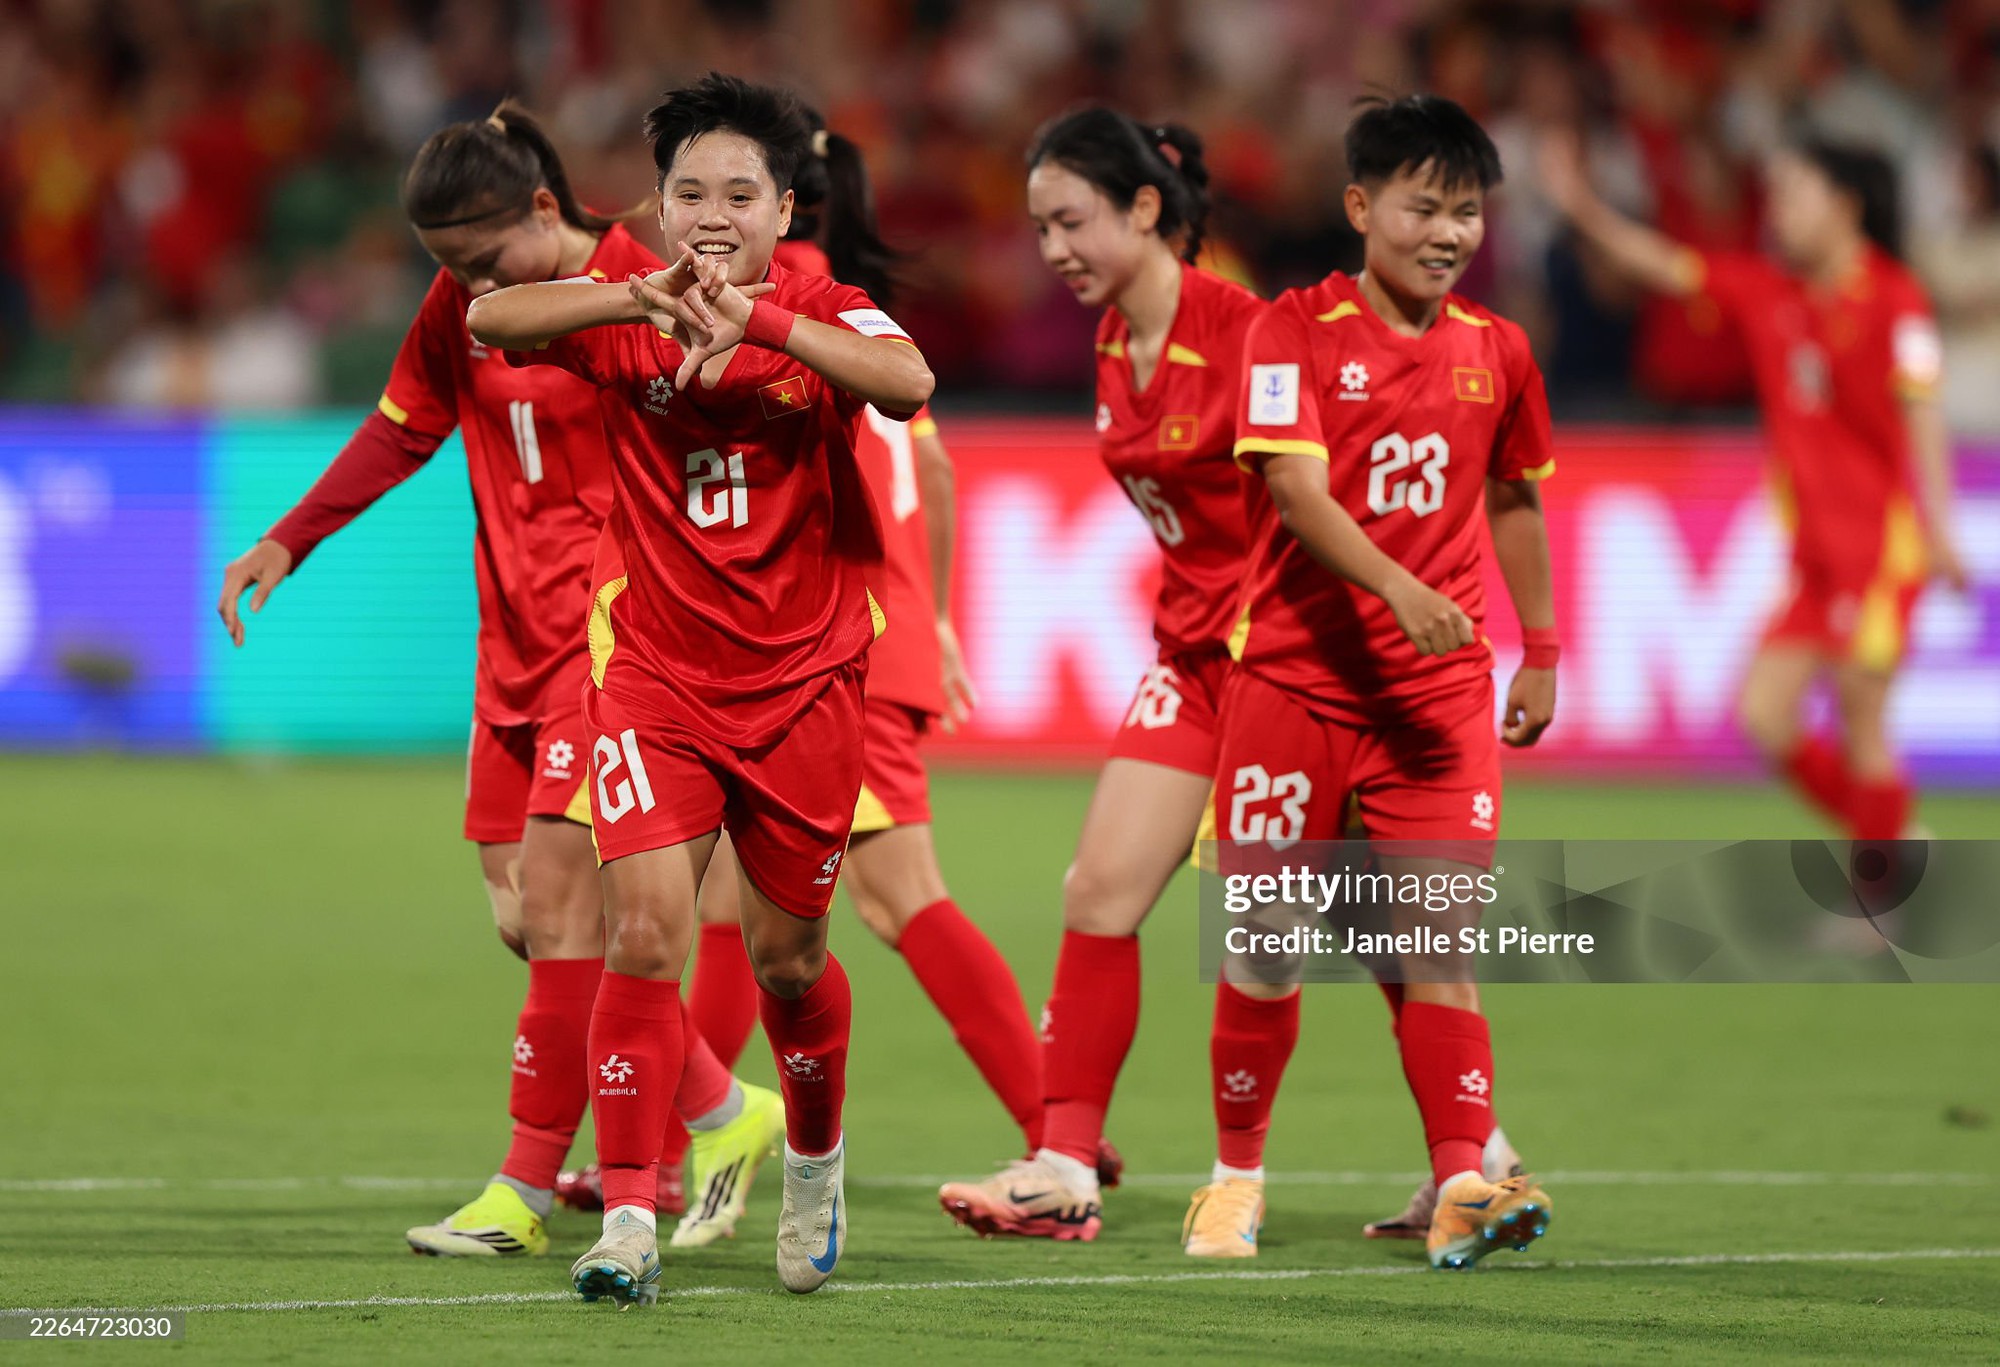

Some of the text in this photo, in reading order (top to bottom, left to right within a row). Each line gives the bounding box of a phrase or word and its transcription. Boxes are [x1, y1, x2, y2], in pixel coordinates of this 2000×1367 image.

[509, 400, 544, 485] 11
[1367, 431, 1450, 518] 23
[686, 448, 749, 529] 21
[1123, 475, 1185, 547] 15
[593, 728, 656, 824] 21
[1229, 763, 1312, 852] 23
